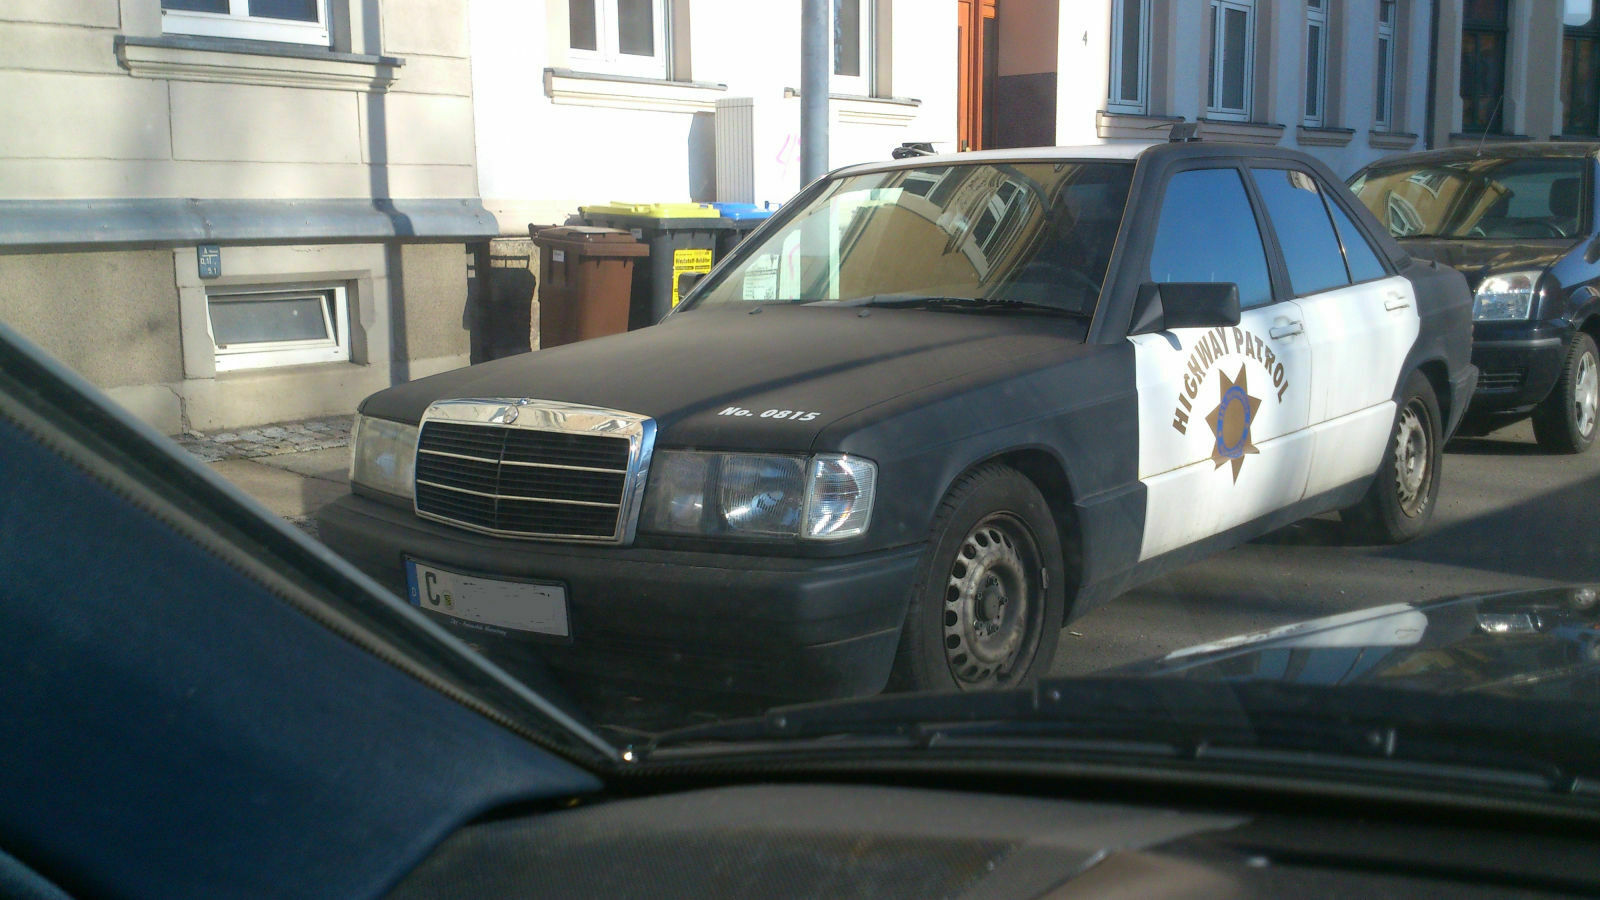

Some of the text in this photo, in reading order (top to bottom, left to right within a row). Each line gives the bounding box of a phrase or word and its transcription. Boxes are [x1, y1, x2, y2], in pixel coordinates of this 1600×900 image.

[1081, 30, 1088, 46] 4
[1172, 326, 1230, 435] HIGHWAY
[1232, 326, 1289, 404] PATROL
[717, 406, 821, 421] No. 0815
[424, 571, 440, 606] C
